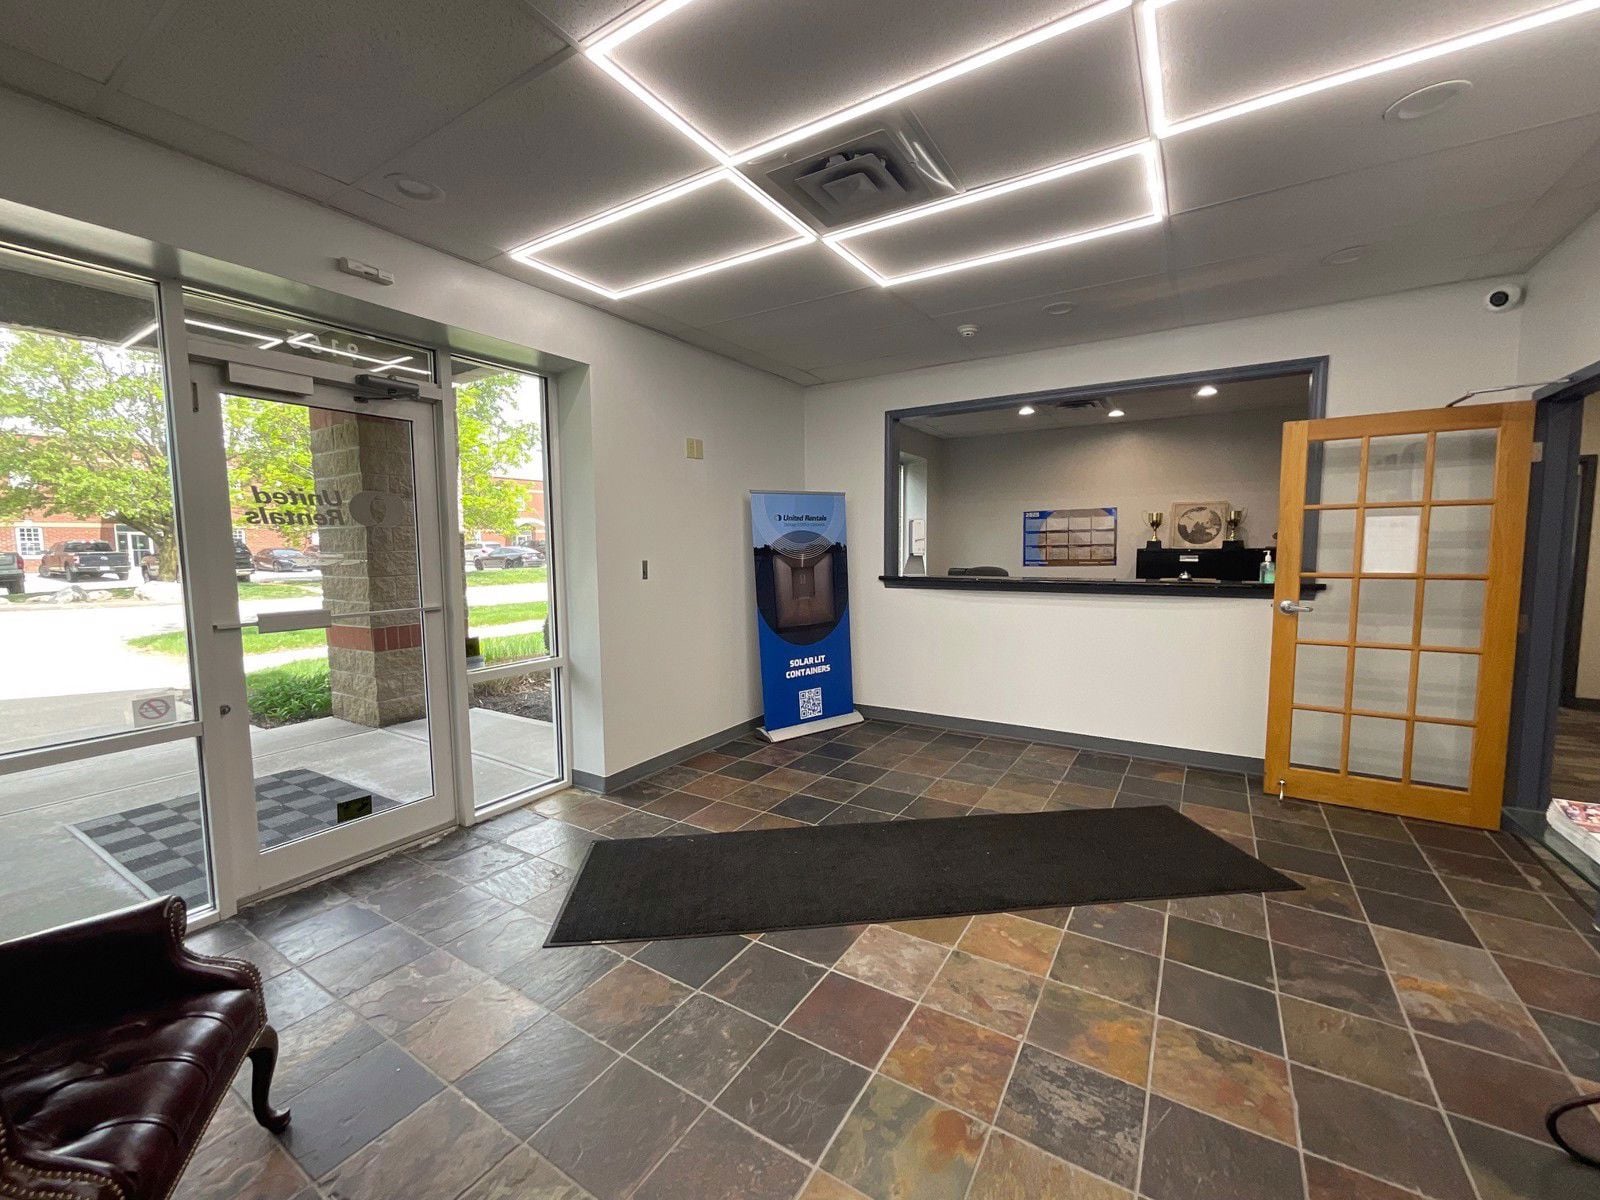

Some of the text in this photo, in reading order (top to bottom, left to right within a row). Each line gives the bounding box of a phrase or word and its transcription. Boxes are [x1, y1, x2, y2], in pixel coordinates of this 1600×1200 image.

[789, 654, 826, 668] SOLAR LIT
[785, 664, 831, 679] CONTAINERS
